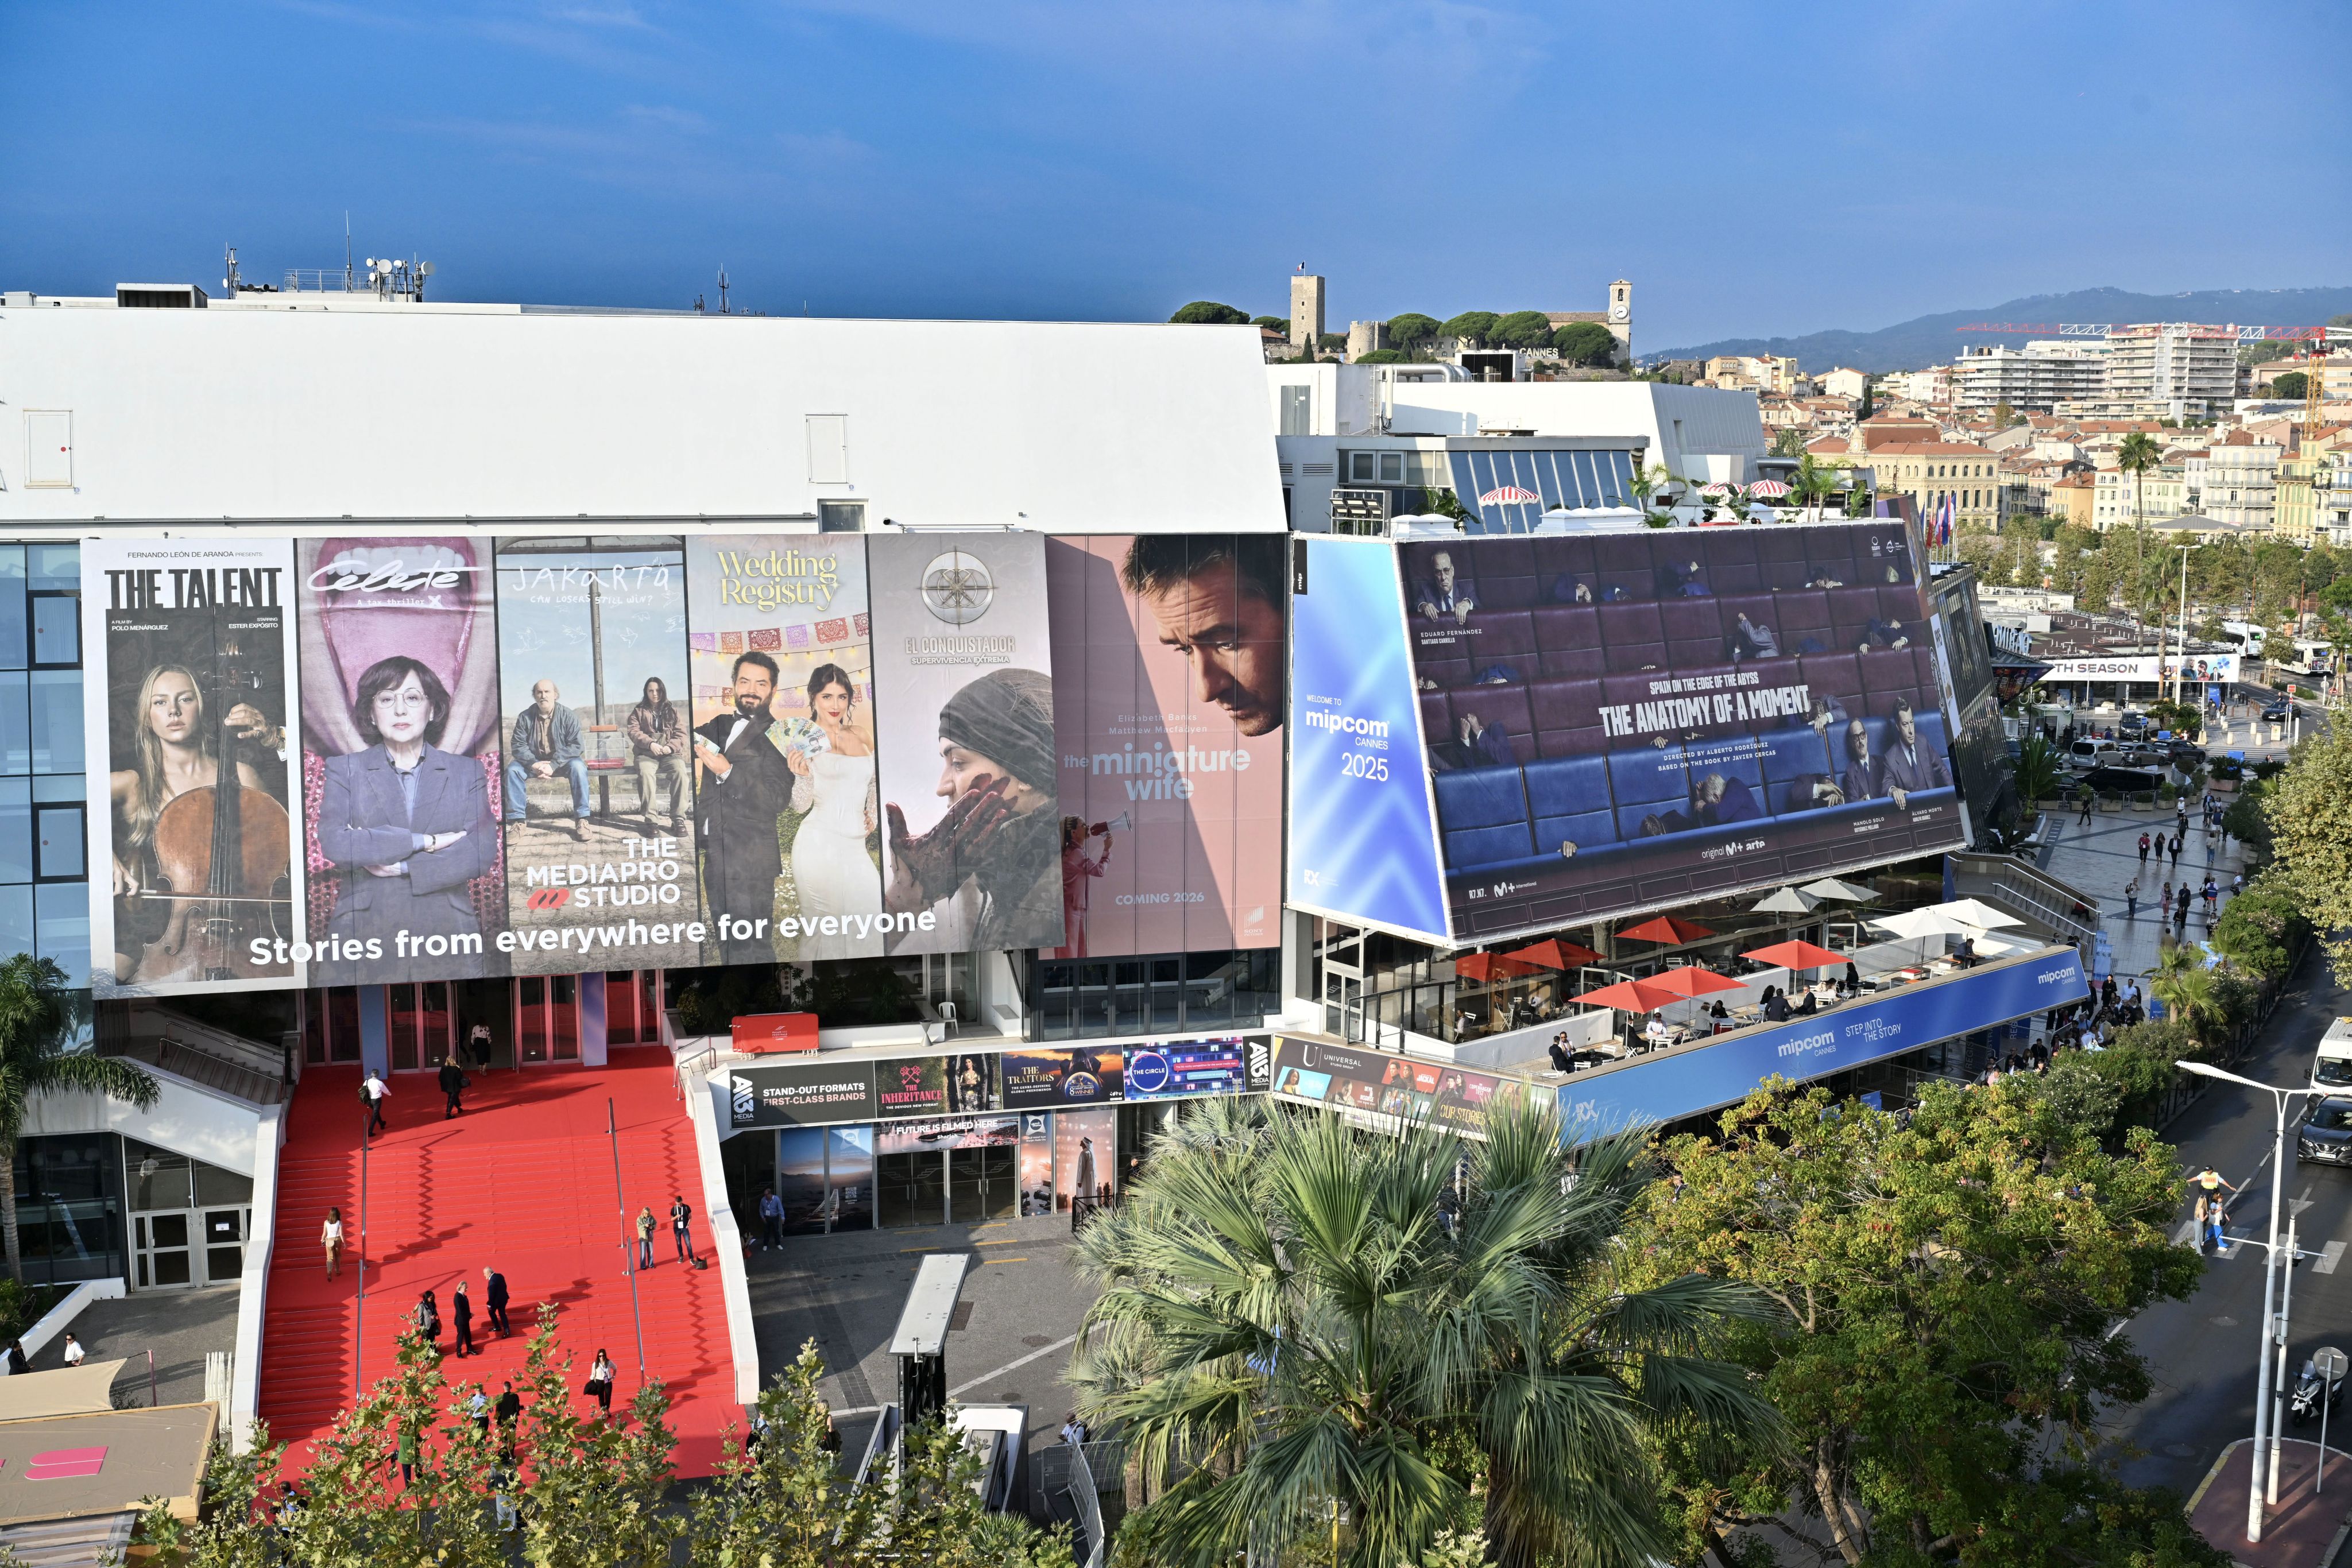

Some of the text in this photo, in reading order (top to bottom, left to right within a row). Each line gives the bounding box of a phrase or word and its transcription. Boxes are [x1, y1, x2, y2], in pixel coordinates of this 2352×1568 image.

[1519, 347, 1559, 356] CANNES
[717, 549, 837, 584] Wedding
[307, 559, 489, 593] Celeste
[105, 568, 283, 609] THE TALENT
[531, 595, 550, 603] CAN
[556, 595, 590, 603] LOSERS
[595, 596, 623, 604] STILL
[906, 636, 1016, 655] EL CONQUISTADOR
[974, 654, 1009, 666] EXTREMA
[2077, 664, 2138, 673] SEASON
[1650, 672, 1759, 695] SPAIN ON THE EDGE OF THE ABYSS
[1306, 694, 1341, 706] WELCOME TO
[1119, 714, 1164, 722] Elizabeth
[1599, 685, 1811, 737] THE ANATOMY OF A MOMENT
[1155, 725, 1207, 734] Macfadyen
[1306, 709, 1388, 737] mipcom
[1355, 737, 1388, 750] CANNES
[1664, 751, 1695, 761] DIRECTED
[1707, 746, 1732, 756] ALBERTO
[1734, 742, 1769, 752] RODRÍGUEZ
[1063, 741, 1251, 775] the miniature
[1341, 752, 1388, 781] 2025
[1658, 763, 1678, 771] BASED
[1732, 753, 1753, 761] JAVIER
[1755, 750, 1776, 758] CERCAS
[1124, 769, 1194, 801] wife
[1853, 819, 1872, 827] MANOLO
[622, 837, 678, 858] THE
[1701, 846, 1725, 860] original
[1746, 840, 1766, 850] arte
[527, 861, 679, 886] MEDIAPRO
[1304, 869, 1320, 887] RX
[574, 883, 680, 908] STUDIO
[1115, 892, 1205, 905] COMING 2026
[250, 911, 936, 966] Stories from everywhere for everyone
[2038, 966, 2075, 984] mipcom
[2062, 977, 2076, 985] CANNES
[1846, 1018, 1882, 1037] STEP INTO
[1863, 1023, 1901, 1043] THE STORY
[1778, 1032, 1834, 1056] mipcom
[1815, 1045, 1836, 1056] CANNES
[1324, 1054, 1361, 1067] UNIVERSAL
[1008, 1074, 1054, 1084] TRAITORS
[1022, 1066, 1039, 1075] THE
[1417, 1075, 1434, 1085] JACKAL
[1469, 1084, 1491, 1092] COPENHAGEN
[763, 1082, 865, 1097] STAND-OUT FORMATS
[881, 1090, 942, 1104] INHERITANCE
[1070, 1087, 1074, 1095] 8
[763, 1092, 866, 1106] FIRST-CLASS BRANDS
[1457, 1108, 1486, 1125] STORIES
[1575, 1099, 1597, 1121] RX
[896, 1120, 998, 1135] FUTURE IS FILMED HERE
